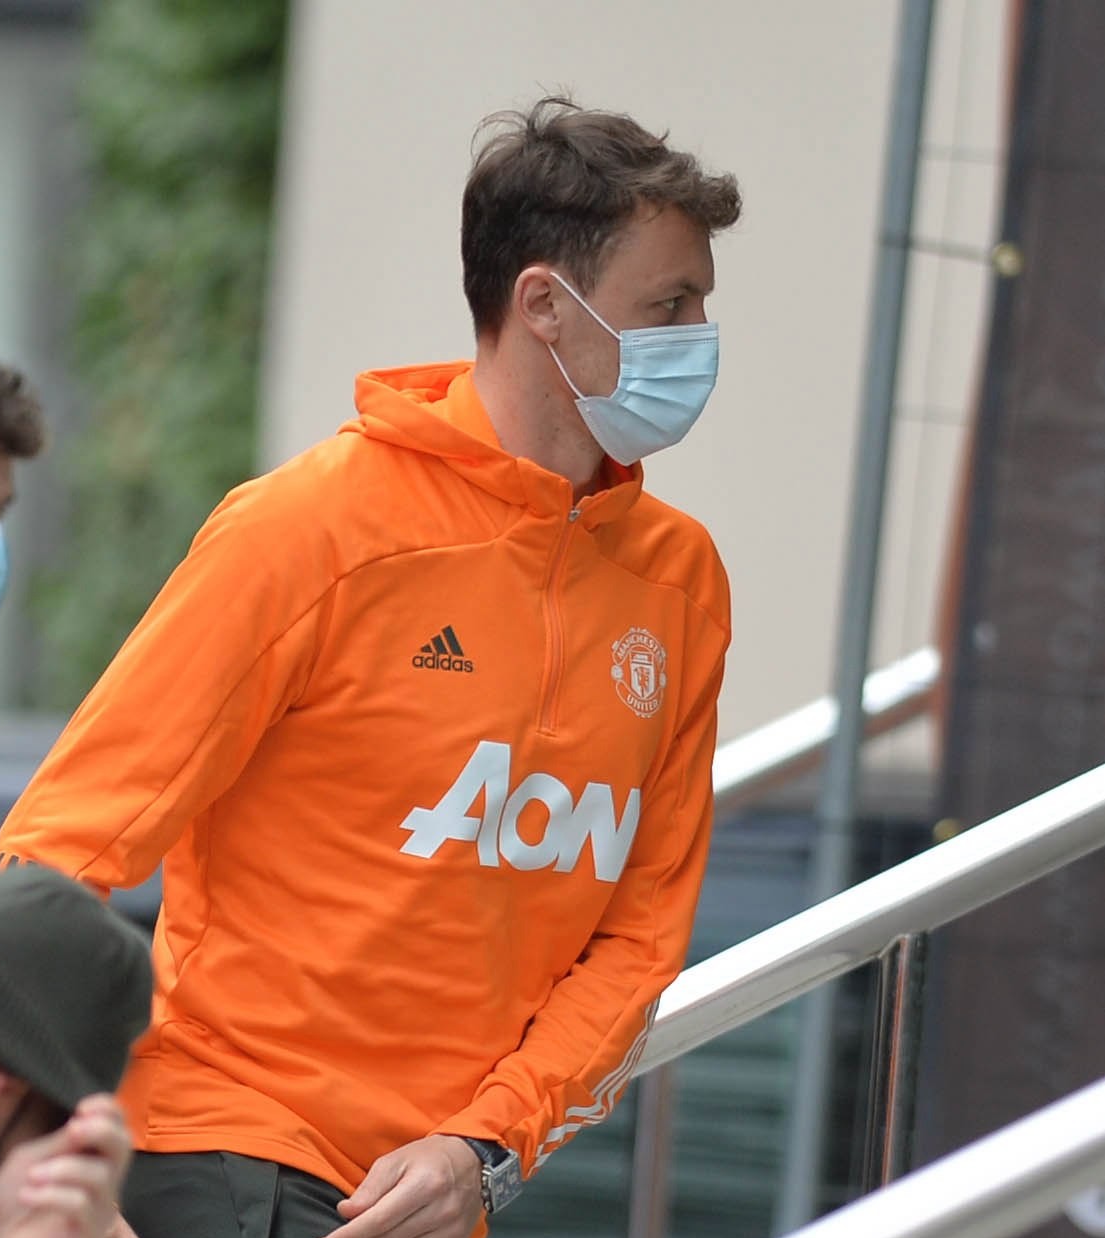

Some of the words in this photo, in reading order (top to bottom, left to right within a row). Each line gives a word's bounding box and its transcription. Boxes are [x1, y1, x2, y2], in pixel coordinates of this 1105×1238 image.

[412, 655, 474, 673] adidas
[626, 694, 659, 712] UNITED
[399, 740, 641, 882] AON
